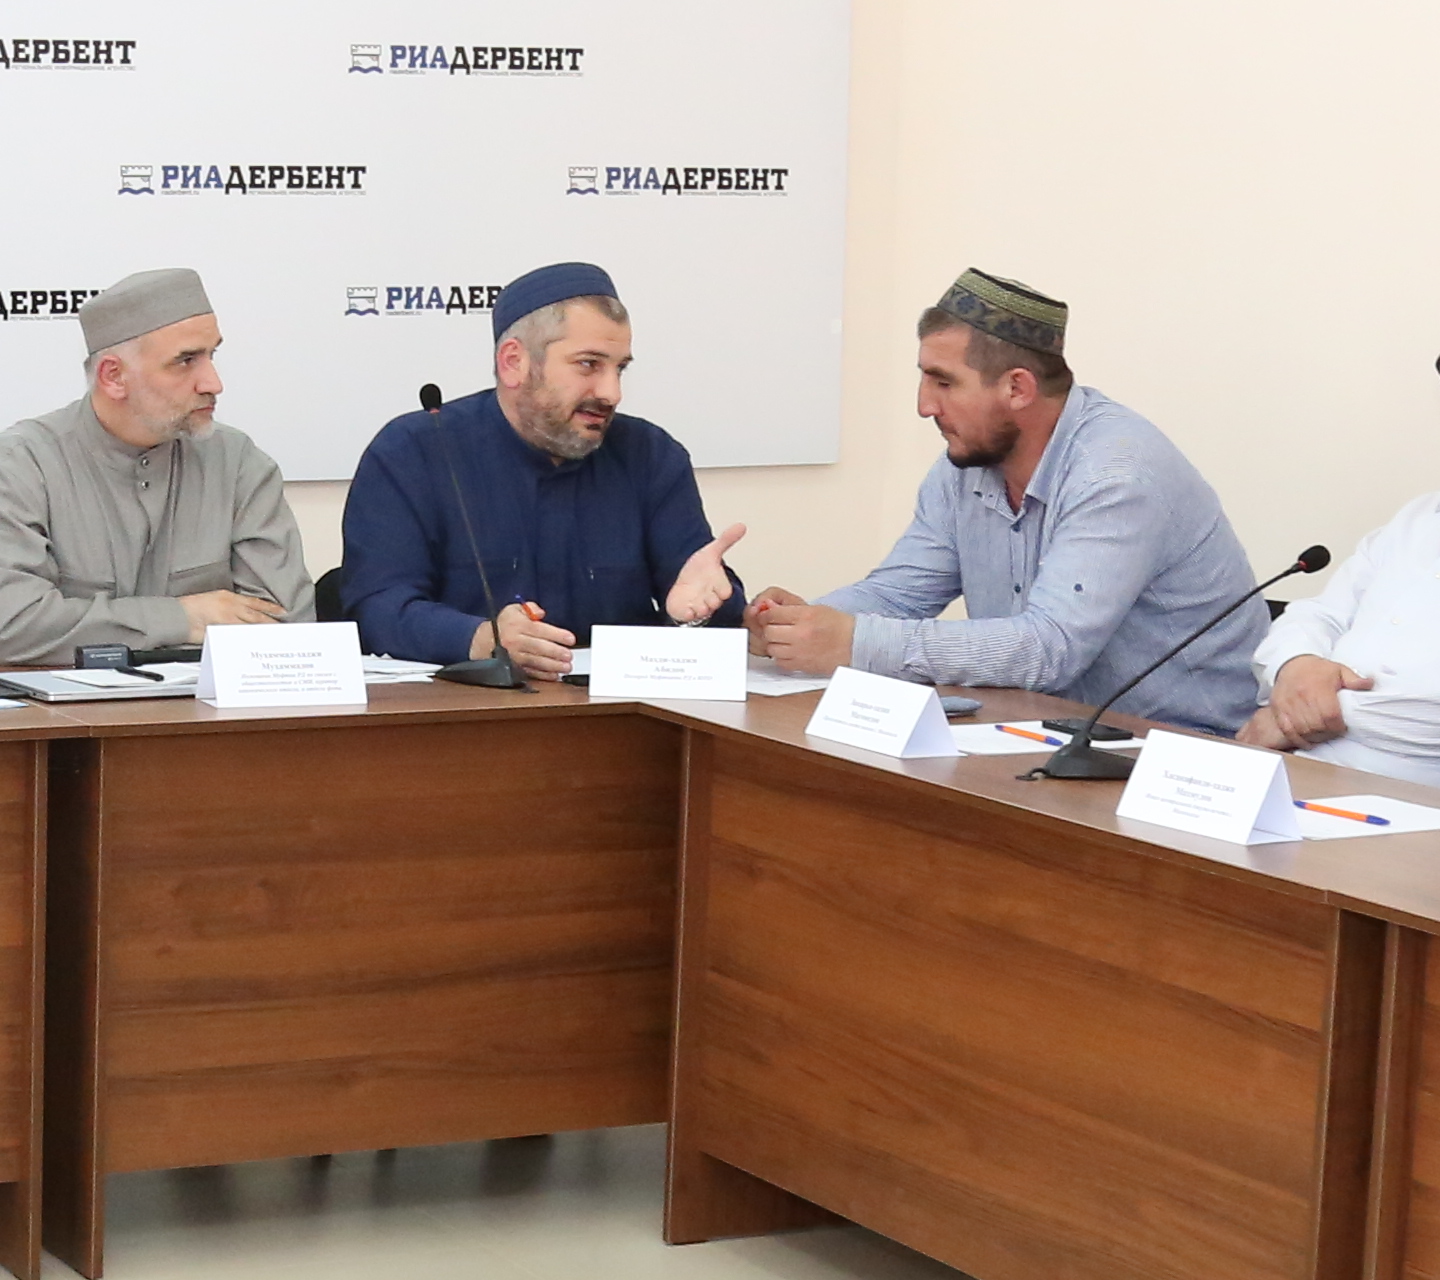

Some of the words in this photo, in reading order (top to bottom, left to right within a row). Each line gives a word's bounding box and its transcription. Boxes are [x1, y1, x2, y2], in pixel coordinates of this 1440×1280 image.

[389, 44, 585, 76] РИАДЕРБЕНТ
[161, 165, 367, 196] РИАДЕРБЕНТ
[605, 166, 789, 196] РИАДЕРБЕНТ
